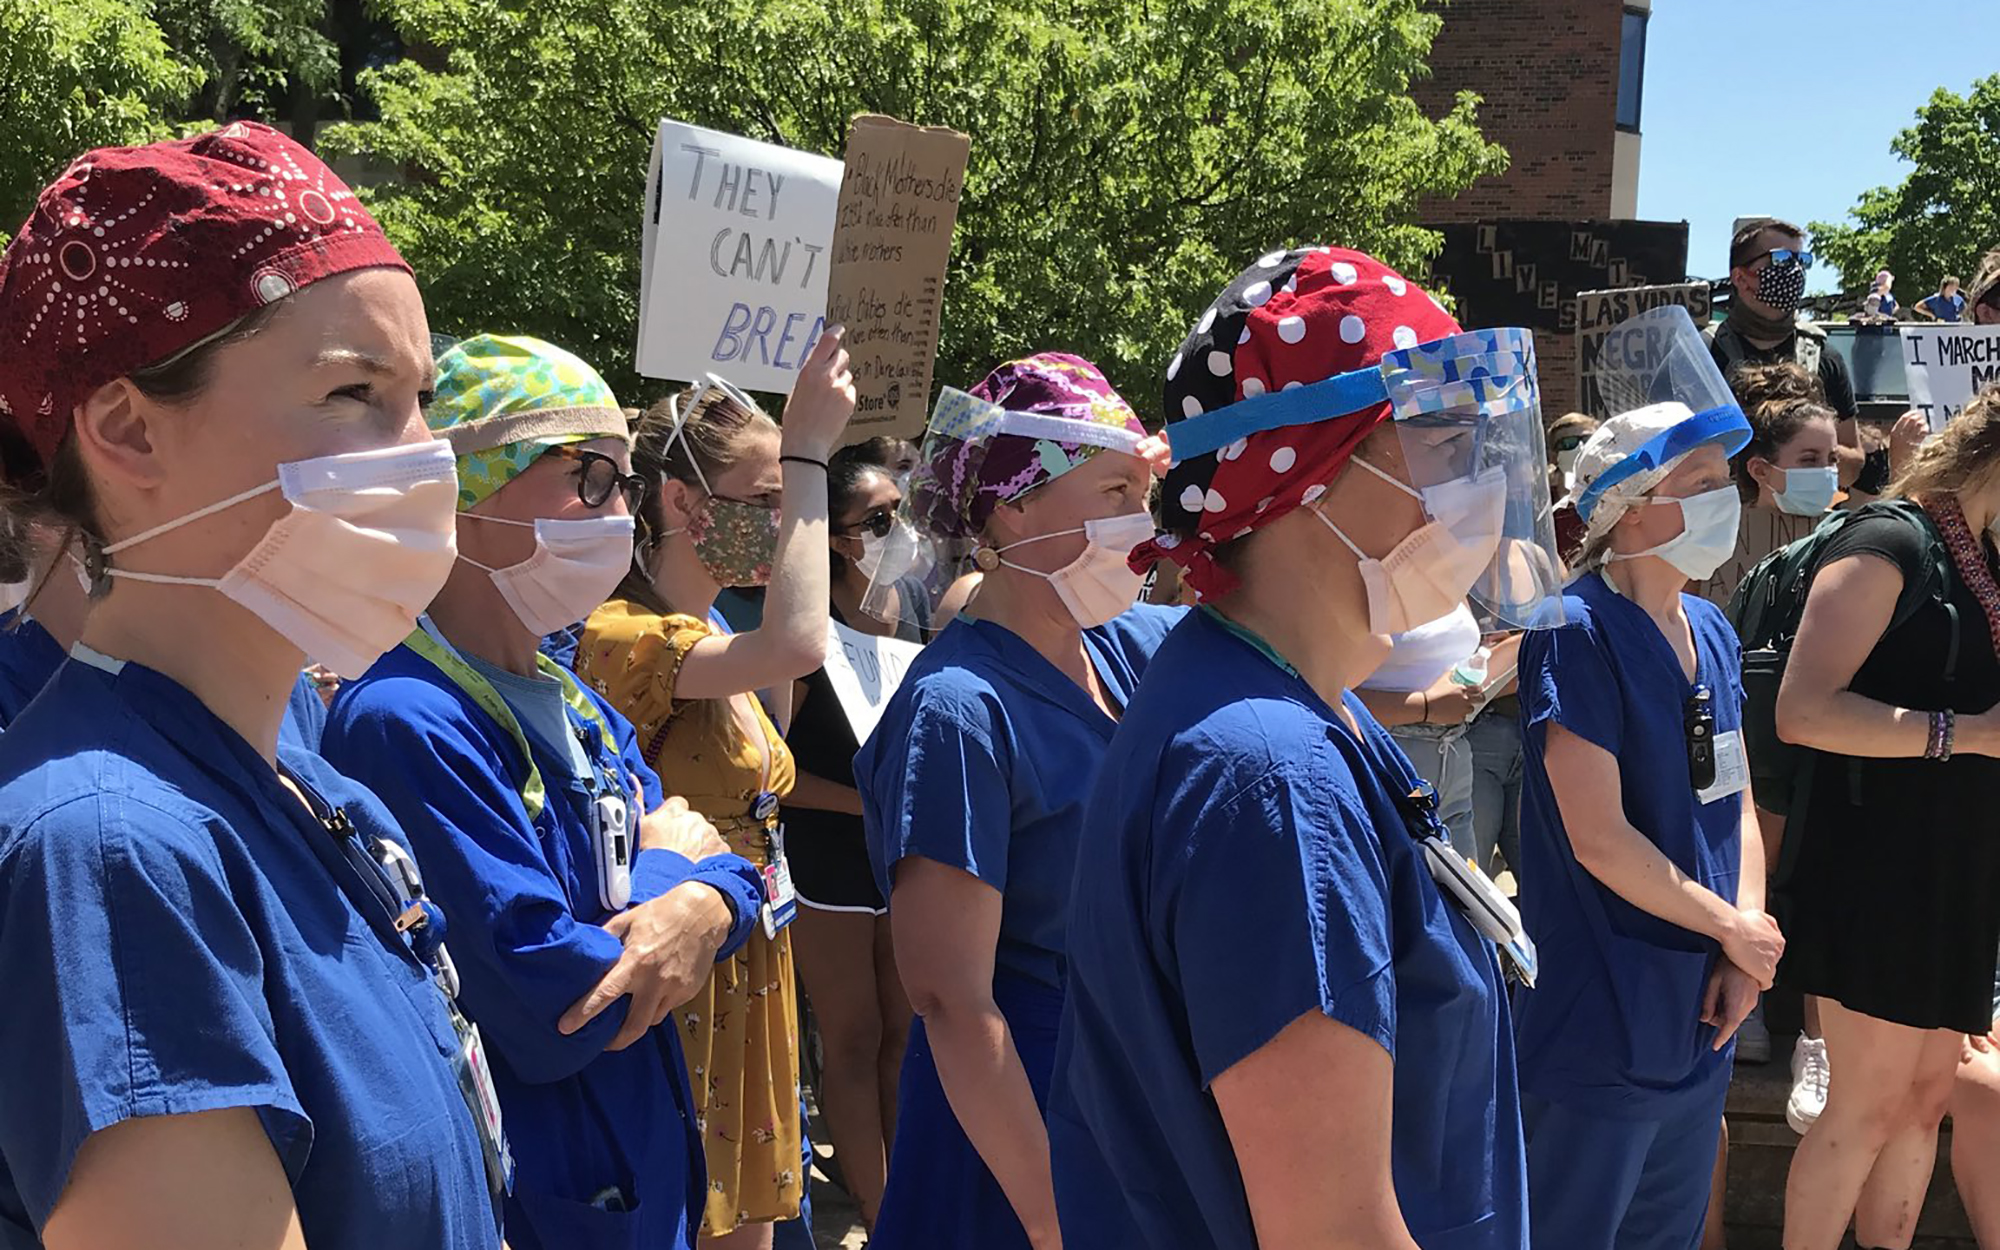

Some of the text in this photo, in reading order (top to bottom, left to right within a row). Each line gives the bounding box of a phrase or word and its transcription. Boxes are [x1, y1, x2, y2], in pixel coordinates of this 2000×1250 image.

[681, 143, 785, 221] THEY
[905, 206, 937, 234] than
[710, 227, 823, 289] CAN'T
[1480, 226, 1577, 327] LIVES
[893, 290, 914, 318] die
[1581, 289, 1708, 330] LAS VIDAS
[1907, 335, 2000, 366] I MARCH
[858, 394, 884, 412] Store
